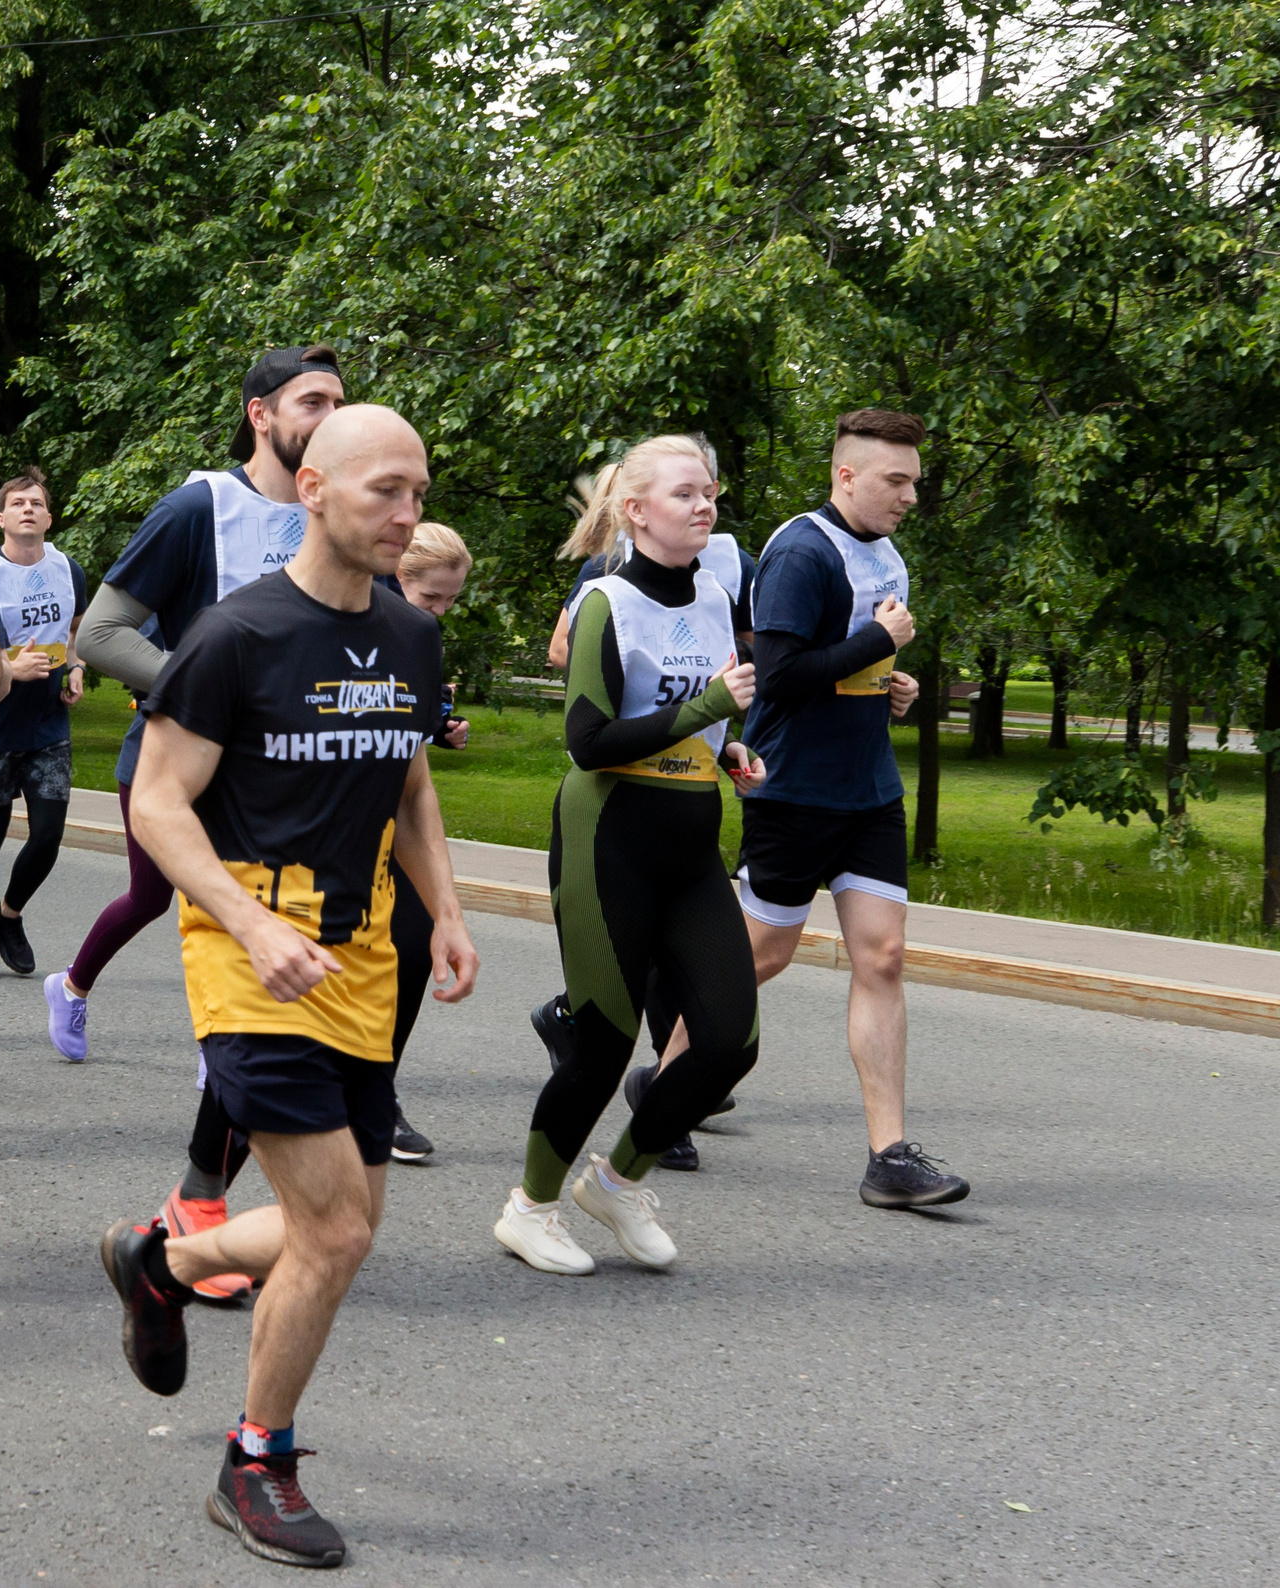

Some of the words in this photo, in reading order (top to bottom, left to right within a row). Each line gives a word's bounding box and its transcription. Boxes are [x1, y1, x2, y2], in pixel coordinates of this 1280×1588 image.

[22, 591, 56, 604] AMTEX
[21, 602, 61, 628] 5258
[662, 655, 713, 667] AMTEX
[305, 693, 334, 705] ГОНКА
[337, 674, 395, 718] URBAN
[654, 674, 713, 707] 524
